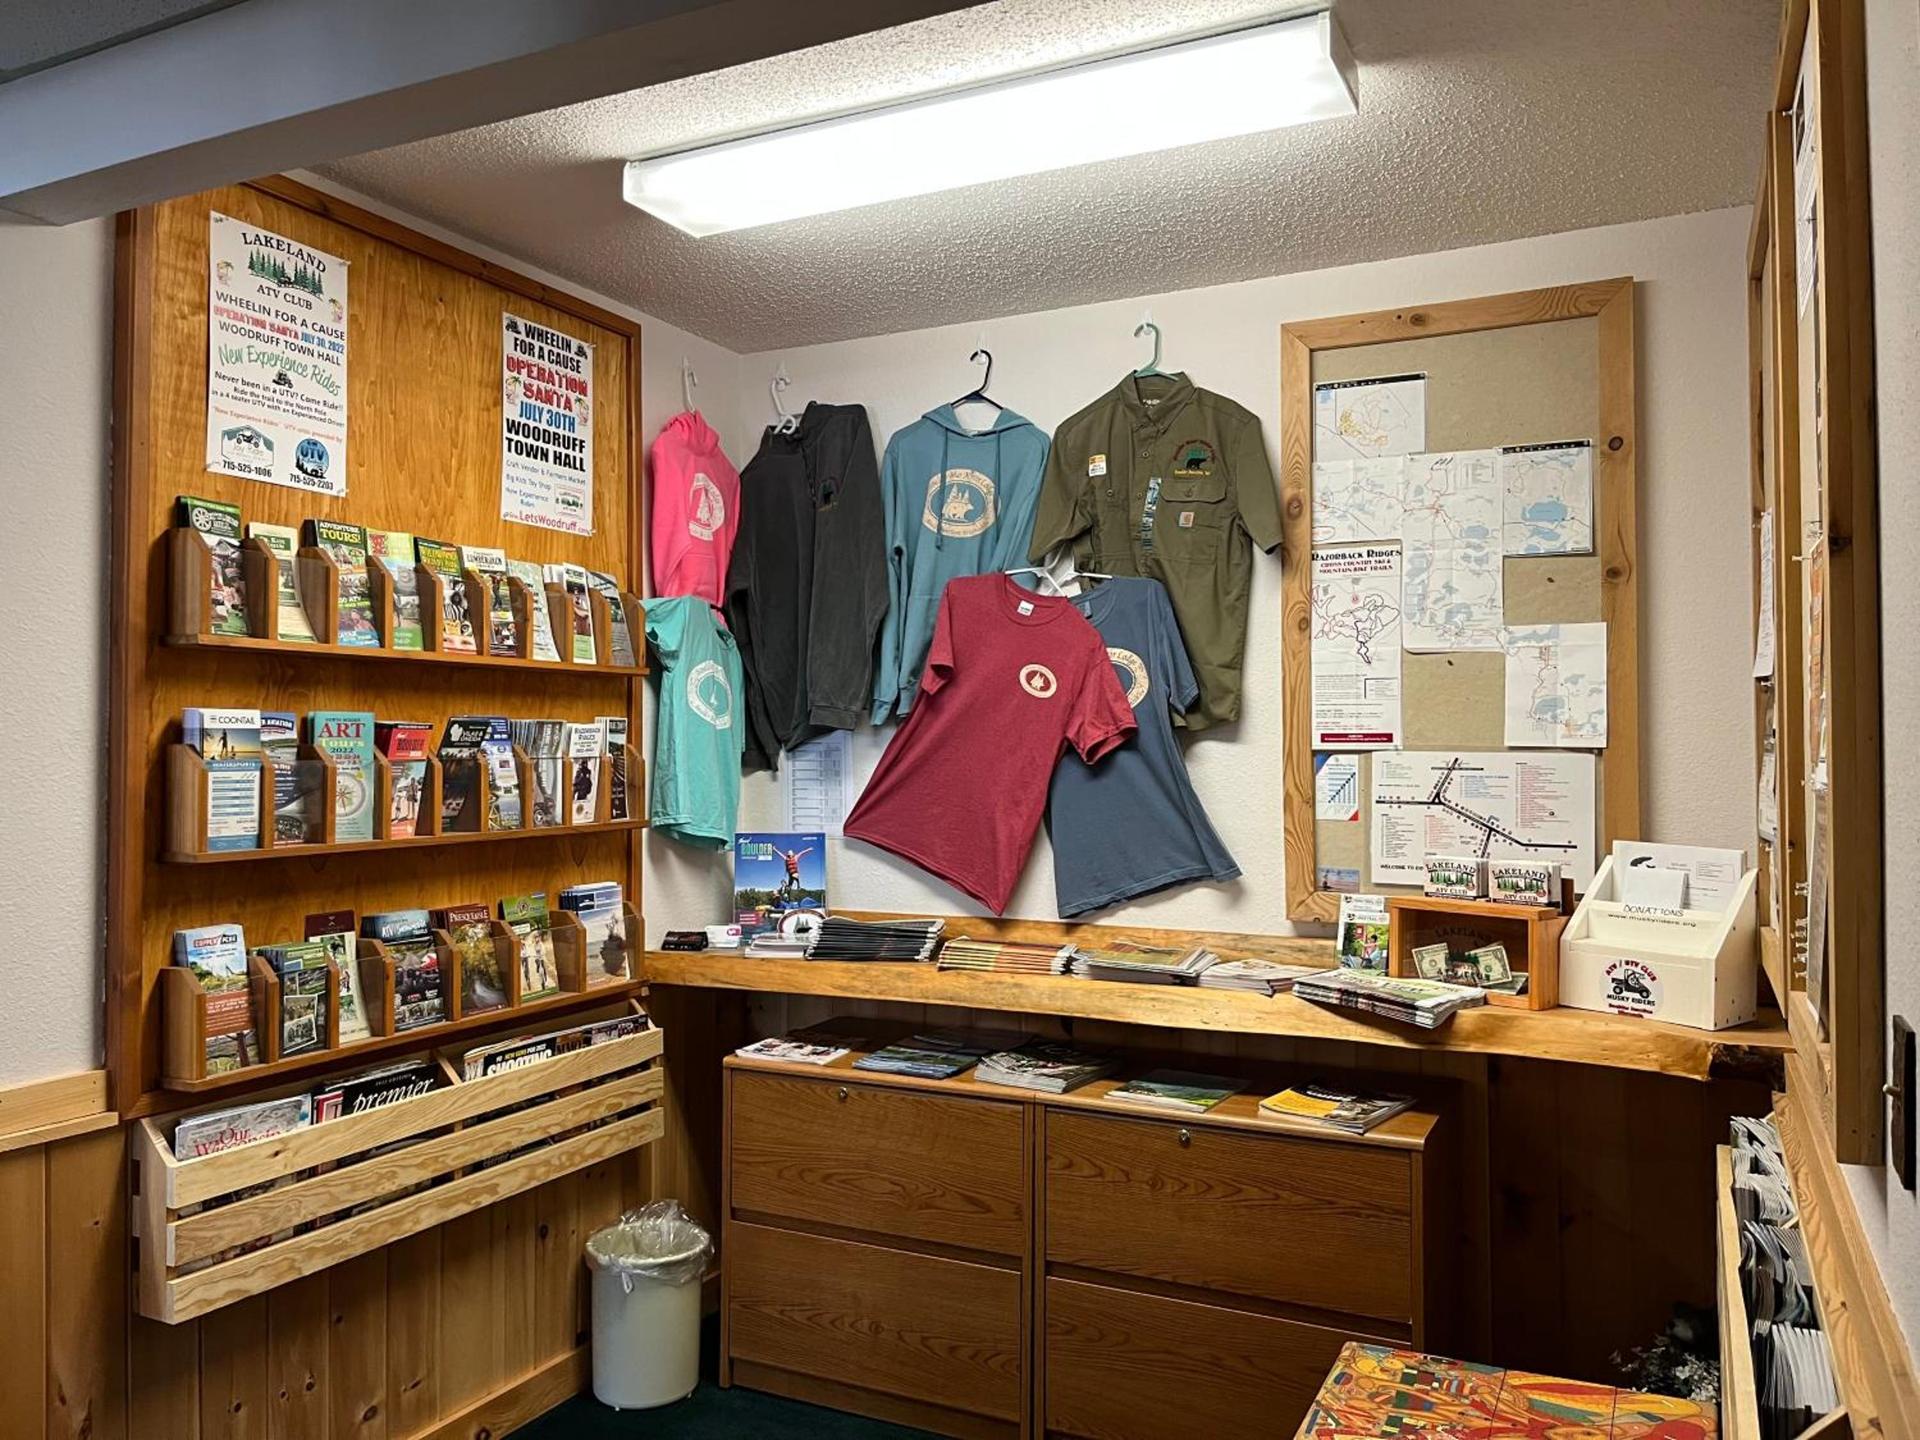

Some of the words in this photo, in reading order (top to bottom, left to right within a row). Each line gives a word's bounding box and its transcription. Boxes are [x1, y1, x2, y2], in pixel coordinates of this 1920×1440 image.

[242, 232, 326, 273] LAKELAND
[257, 284, 280, 299] ATV
[283, 292, 313, 311] CLUB
[214, 305, 266, 330] OPERATION
[269, 323, 299, 341] SANTA
[301, 331, 315, 345] JULY
[216, 290, 271, 317] WHEELIN
[275, 309, 298, 326] FOR
[300, 318, 308, 329] A
[311, 323, 345, 341] CAUSE
[218, 320, 280, 346] WOODRUFF
[284, 342, 314, 358] TOWN
[317, 352, 341, 366] HALL
[525, 322, 571, 354] WHEELIN
[218, 344, 243, 367] New
[247, 345, 308, 379] Experience
[311, 364, 341, 397] Rides
[514, 337, 535, 358] FOR
[538, 345, 545, 362] A
[548, 350, 581, 374] CAUSE
[215, 371, 239, 385] Never
[241, 377, 260, 389] been
[279, 388, 298, 400] UTV?
[300, 394, 321, 405] Come
[506, 354, 588, 397] OPERATION
[523, 381, 573, 412] SANTA
[519, 400, 544, 424] JULY
[546, 409, 576, 434] 30TH
[506, 418, 586, 453] WOODRUFF
[300, 446, 324, 461] UTV
[505, 437, 549, 463] TOWN
[553, 451, 586, 472] HALL
[319, 529, 361, 544] TOURS!
[218, 716, 255, 725] COONTAIL
[318, 722, 365, 738] ART
[321, 738, 365, 748] Tours
[1425, 862, 1477, 873] LAKELAND
[1492, 868, 1546, 880] LAKELAND
[1623, 904, 1685, 917] DONATIONS
[1605, 962, 1618, 976] ATV
[1624, 959, 1640, 968] UTV
[1641, 965, 1657, 982] CLUB
[1606, 993, 1629, 1002] MUSKY
[1631, 996, 1656, 1006] RIDERS
[353, 1078, 434, 1115] premier
[219, 1126, 251, 1144] Our
